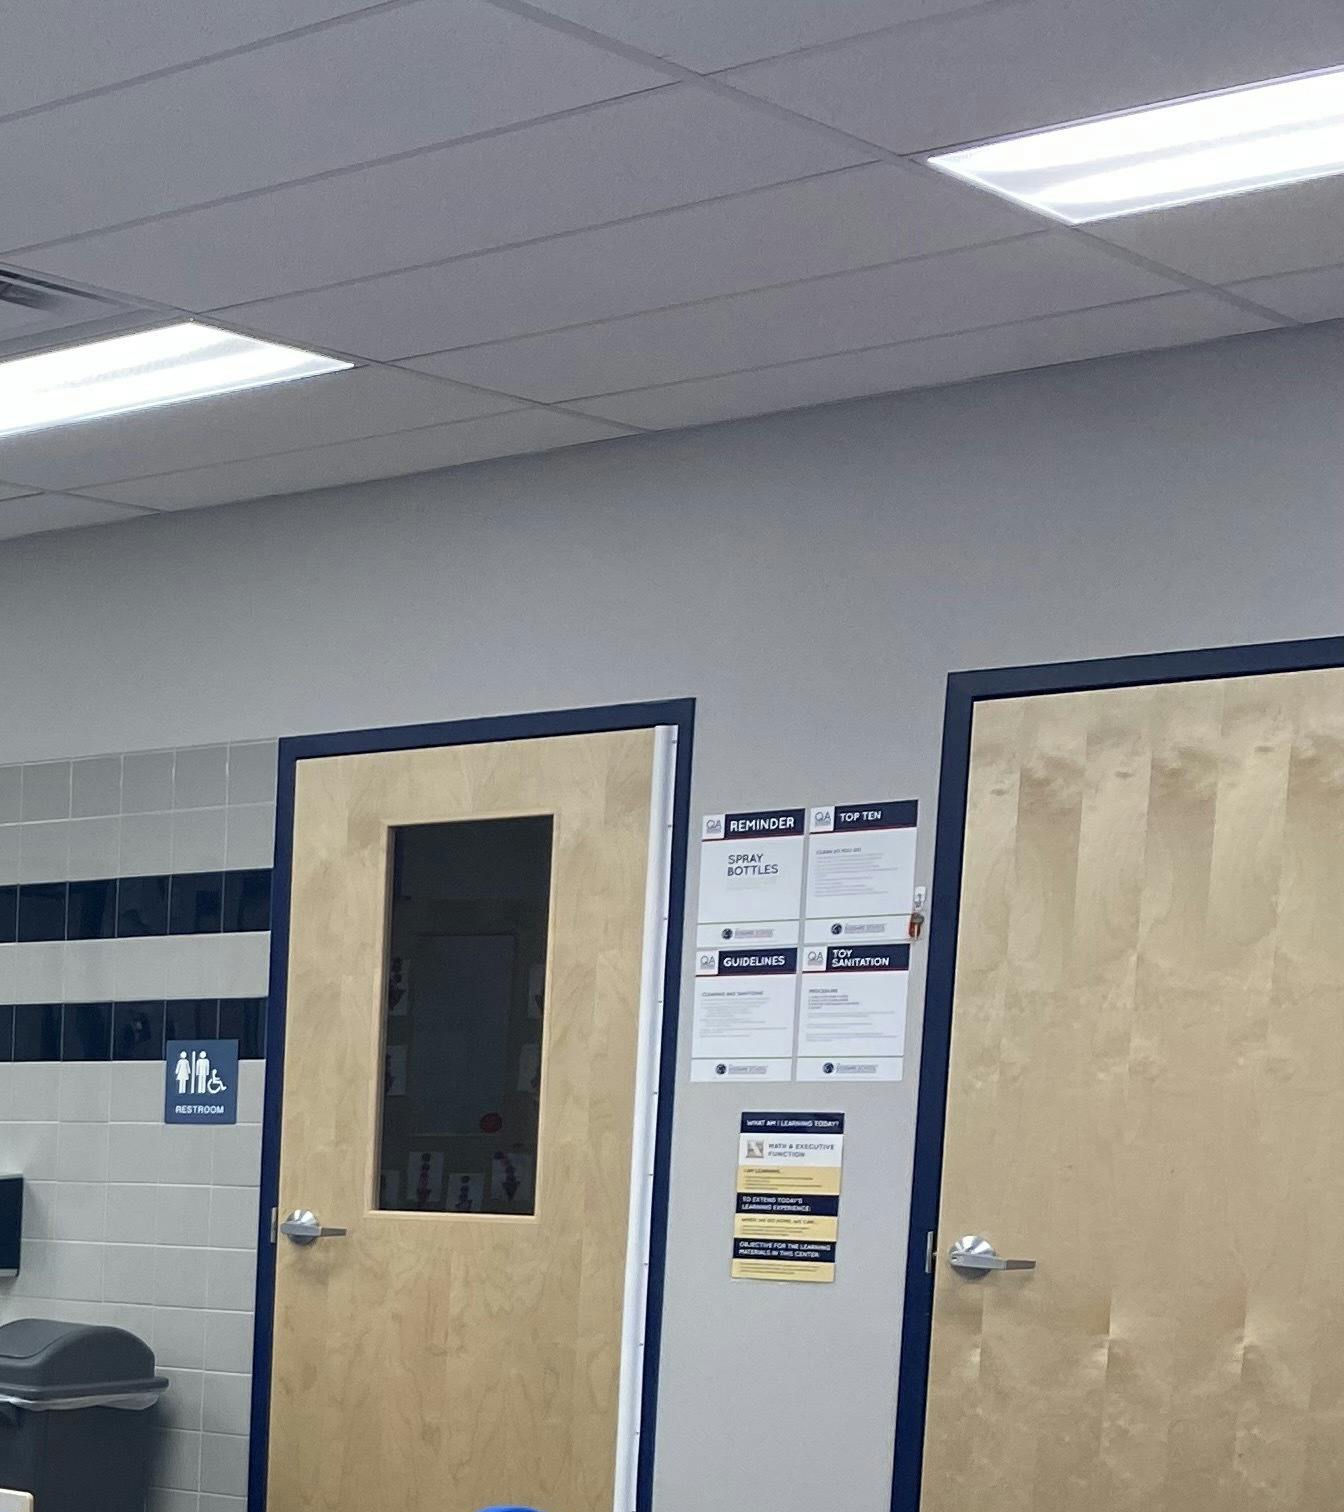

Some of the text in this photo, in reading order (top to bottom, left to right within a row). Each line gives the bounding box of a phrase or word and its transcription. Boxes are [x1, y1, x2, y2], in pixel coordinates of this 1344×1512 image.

[815, 811, 831, 821] QA
[840, 811, 881, 821] TOP TEN
[706, 820, 721, 829] QA
[730, 817, 795, 832] REMINDER
[728, 853, 763, 865] SPRAY
[728, 864, 779, 877] BOTTLES
[808, 951, 823, 961] QA
[833, 949, 853, 958] TOY
[701, 956, 715, 965] QA
[723, 956, 785, 967] GUIDELINES
[832, 957, 889, 968] SANITATION
[175, 1105, 224, 1114] RESTROOM
